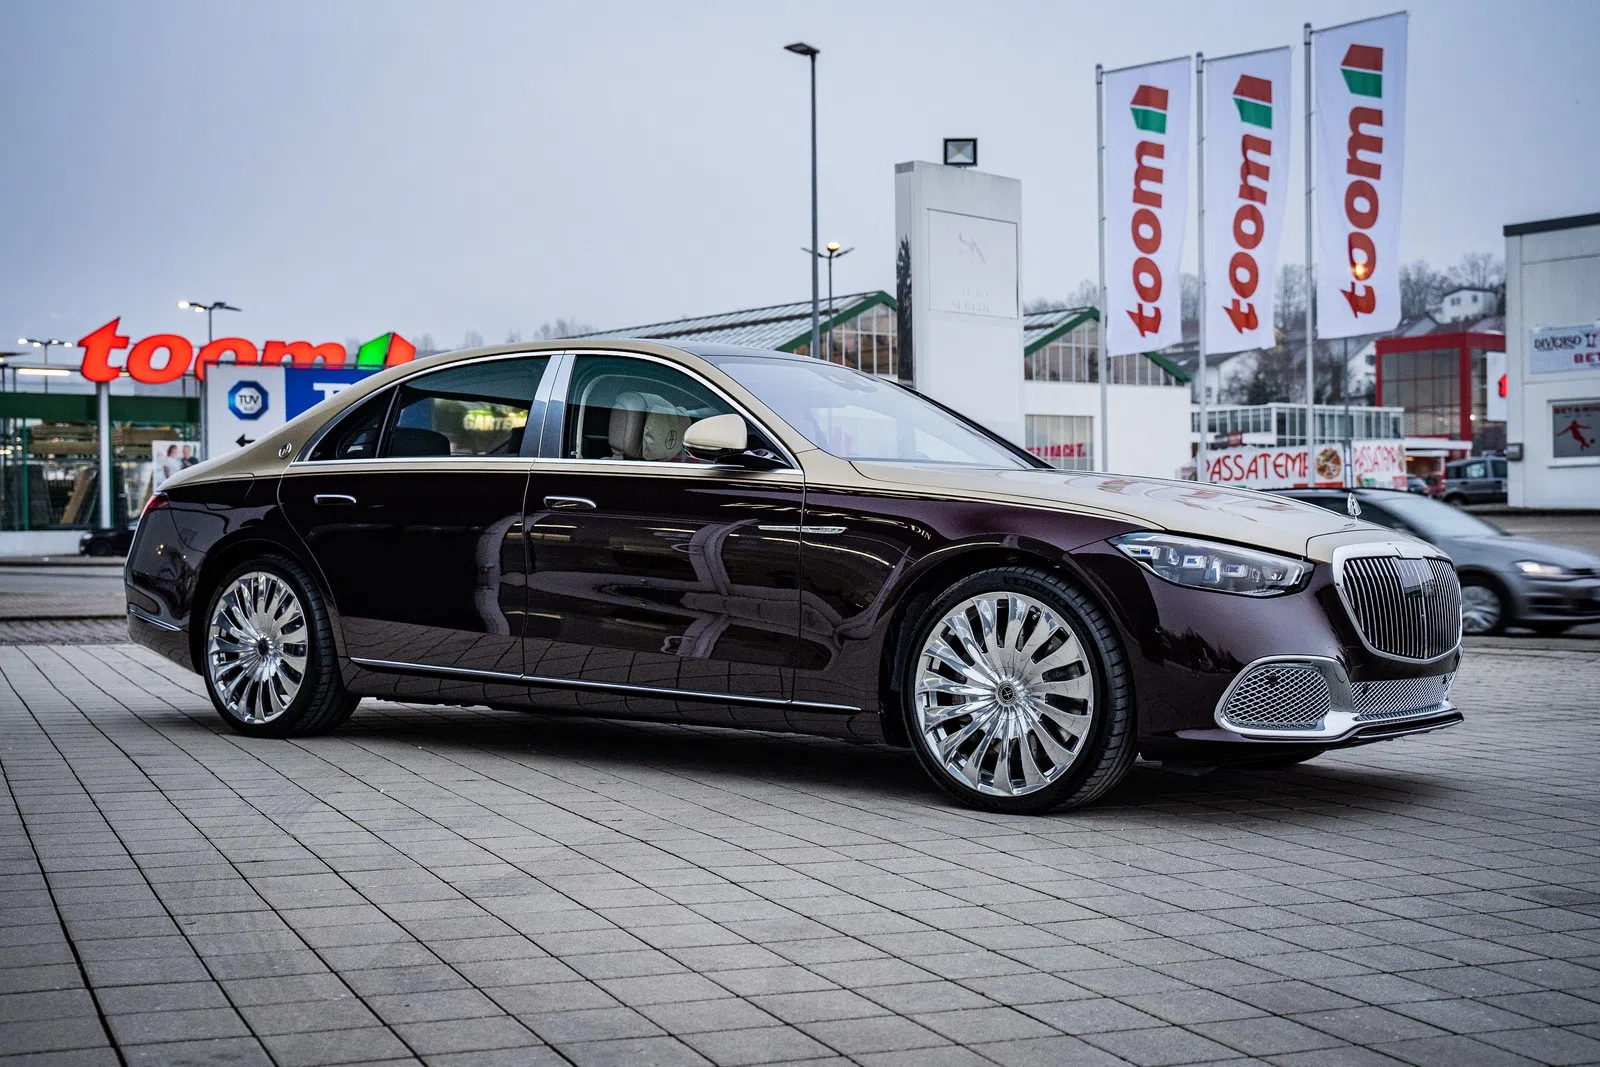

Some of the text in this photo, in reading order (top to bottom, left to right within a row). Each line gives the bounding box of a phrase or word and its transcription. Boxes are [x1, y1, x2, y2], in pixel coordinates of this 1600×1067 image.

[1125, 140, 1165, 337] toom
[1222, 133, 1272, 334] toom
[1340, 106, 1384, 318] toom
